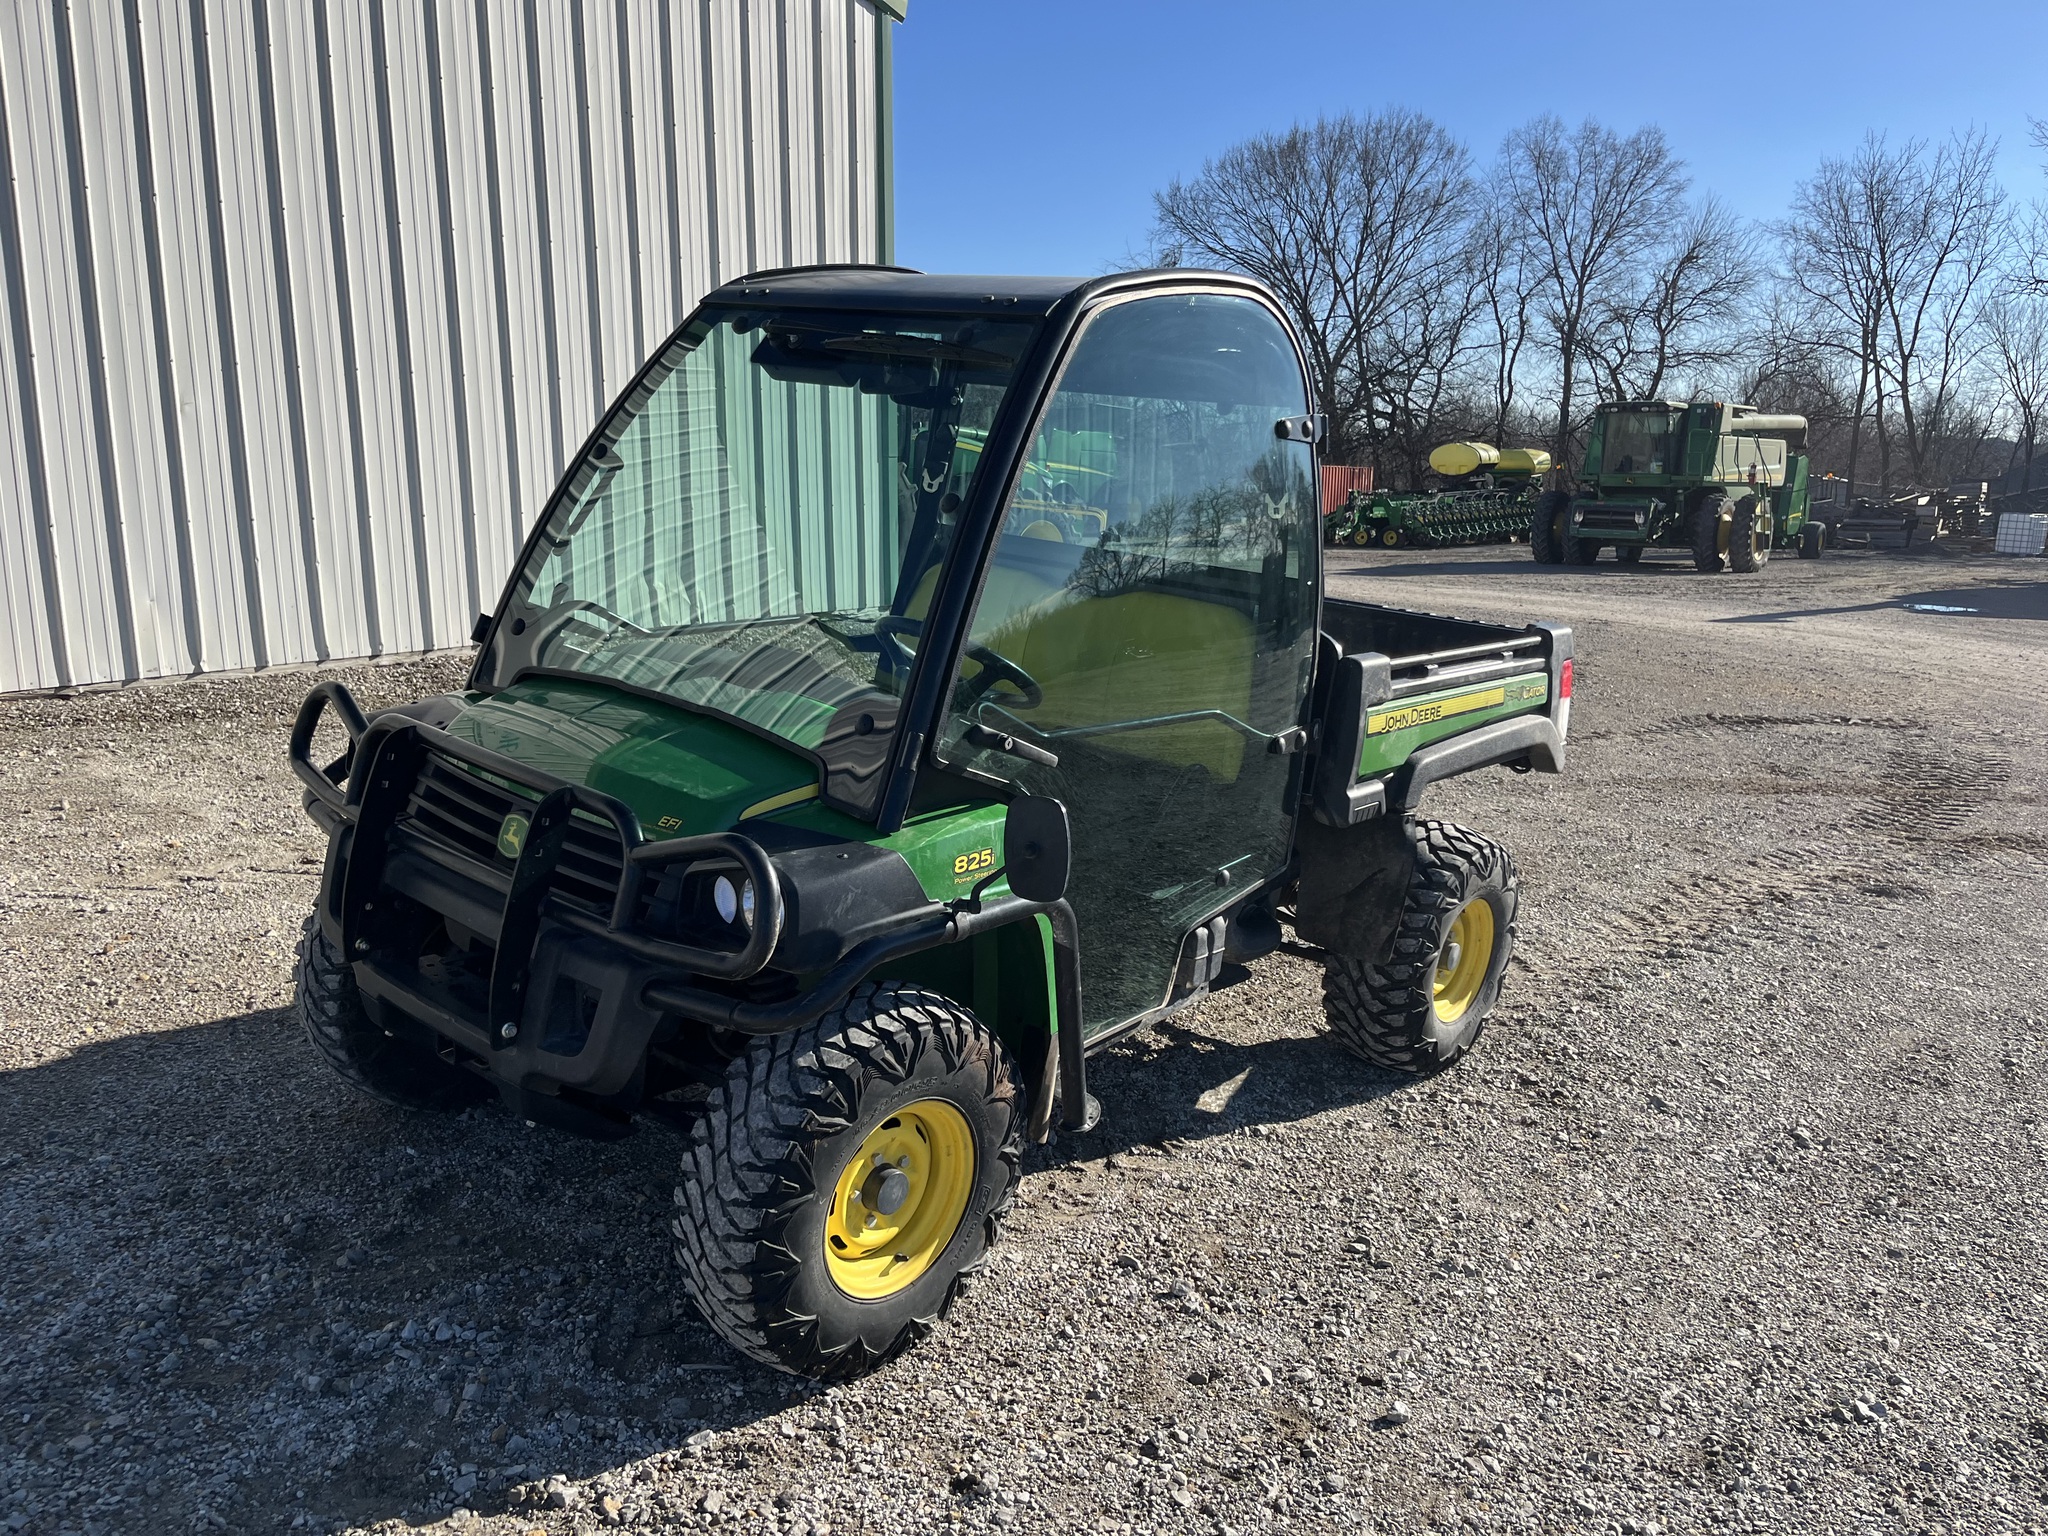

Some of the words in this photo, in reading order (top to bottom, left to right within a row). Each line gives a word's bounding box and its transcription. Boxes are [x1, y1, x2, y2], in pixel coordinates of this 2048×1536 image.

[1523, 685, 1546, 700] GATOR
[1381, 713, 1411, 731] JOHN
[1411, 706, 1442, 724] DEERE
[657, 815, 683, 830] EFI
[954, 848, 995, 874] 825i
[954, 876, 973, 885] Power
